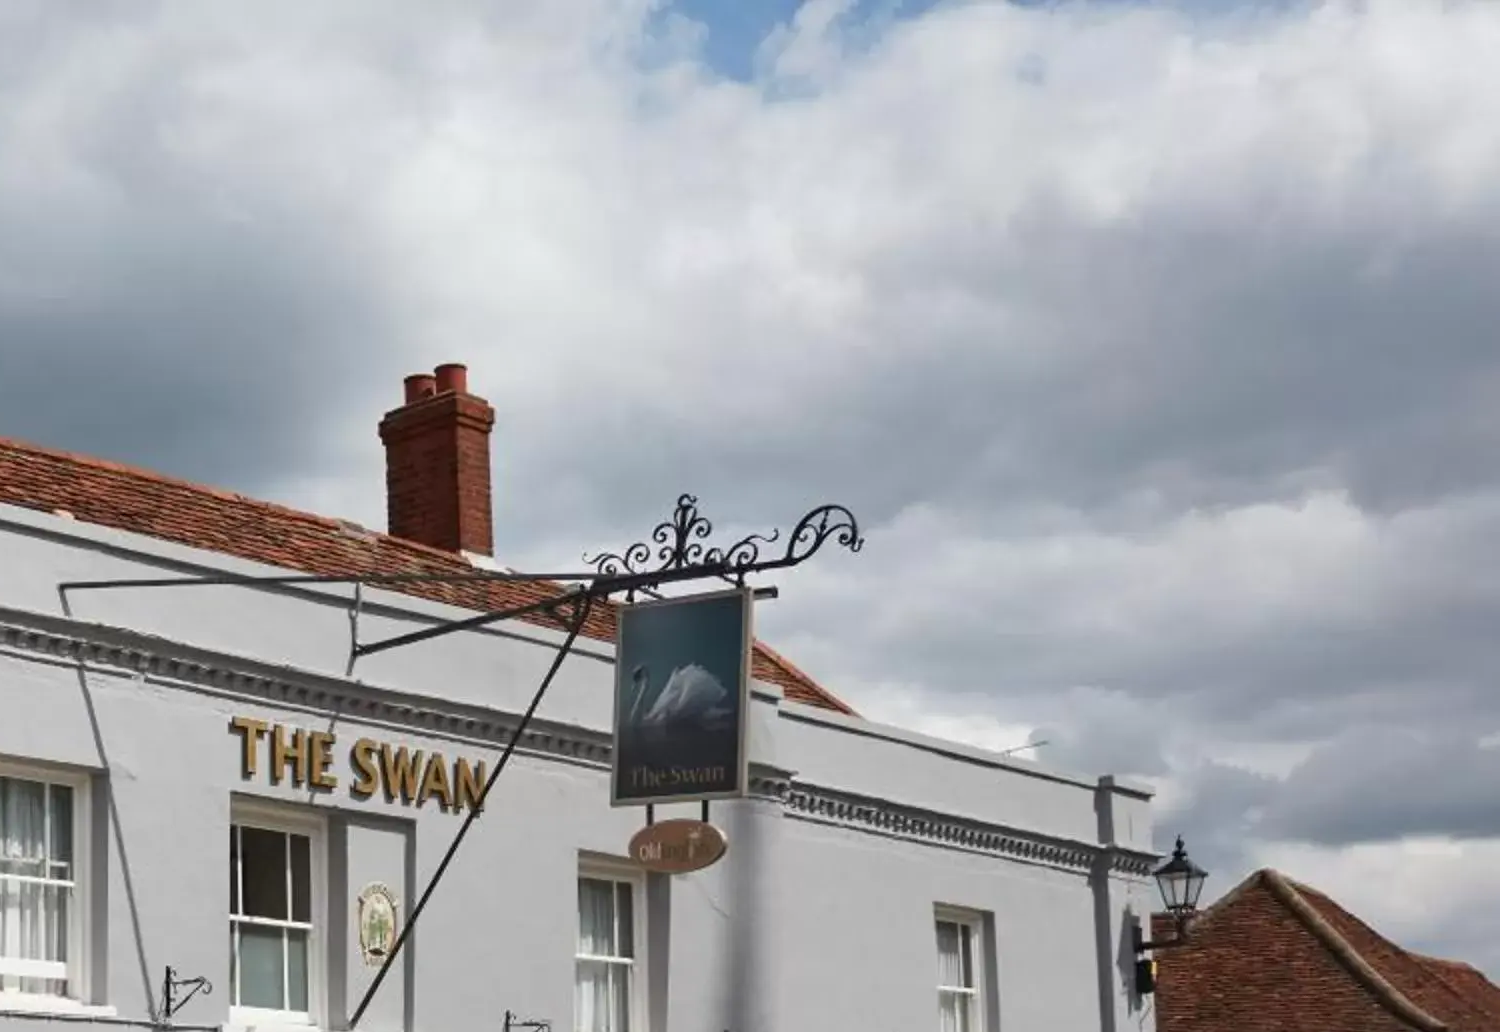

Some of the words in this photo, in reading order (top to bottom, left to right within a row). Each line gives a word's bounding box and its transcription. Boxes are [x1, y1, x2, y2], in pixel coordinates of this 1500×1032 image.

[231, 716, 338, 789] THE
[351, 736, 486, 813] SWAN
[630, 765, 663, 788] The
[669, 764, 725, 785] Swan
